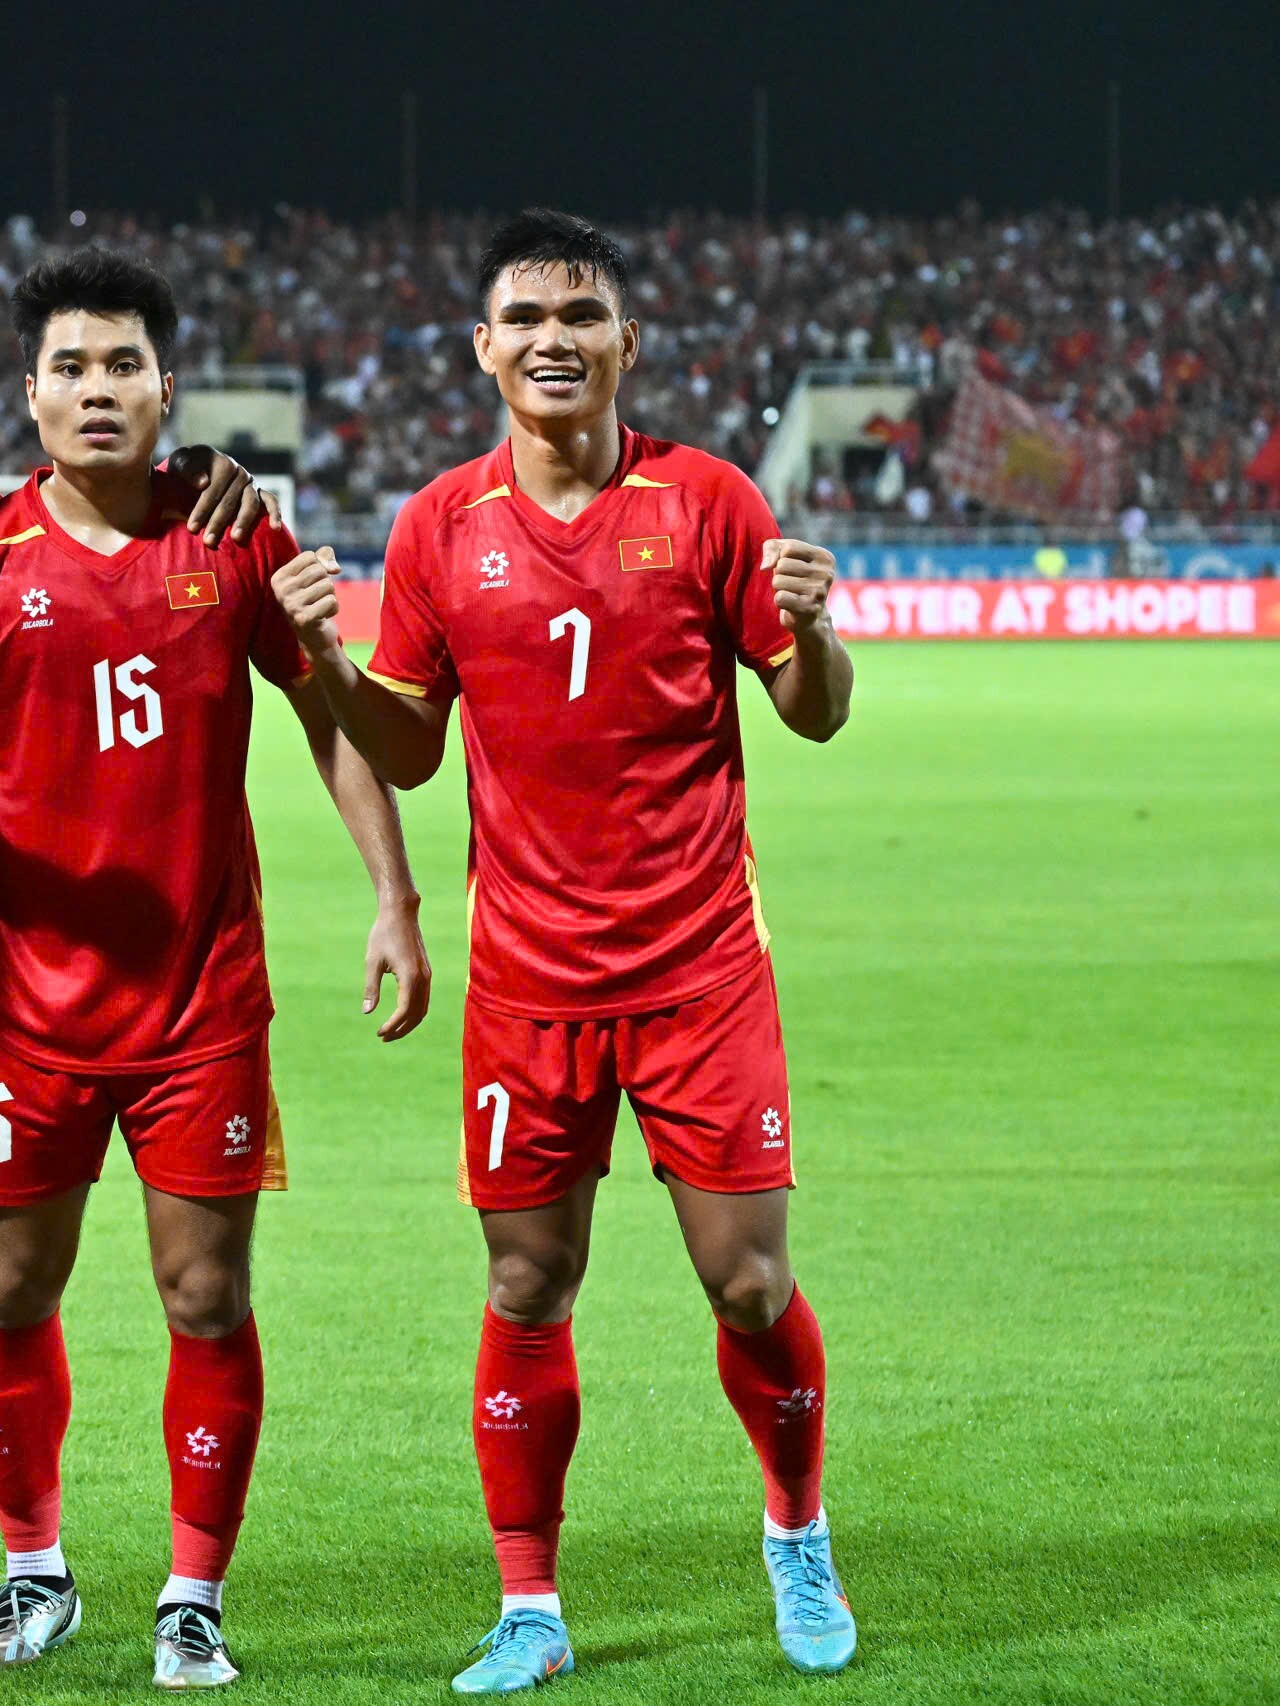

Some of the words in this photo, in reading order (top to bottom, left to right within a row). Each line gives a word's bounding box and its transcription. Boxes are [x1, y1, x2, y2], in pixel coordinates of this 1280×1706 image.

[21, 618, 55, 630] JOGARBOLA
[548, 606, 592, 702] 7
[990, 585, 1055, 634] AT
[1063, 584, 1257, 633] SHOPEE
[92, 652, 164, 753] 15
[477, 1081, 510, 1172] 7
